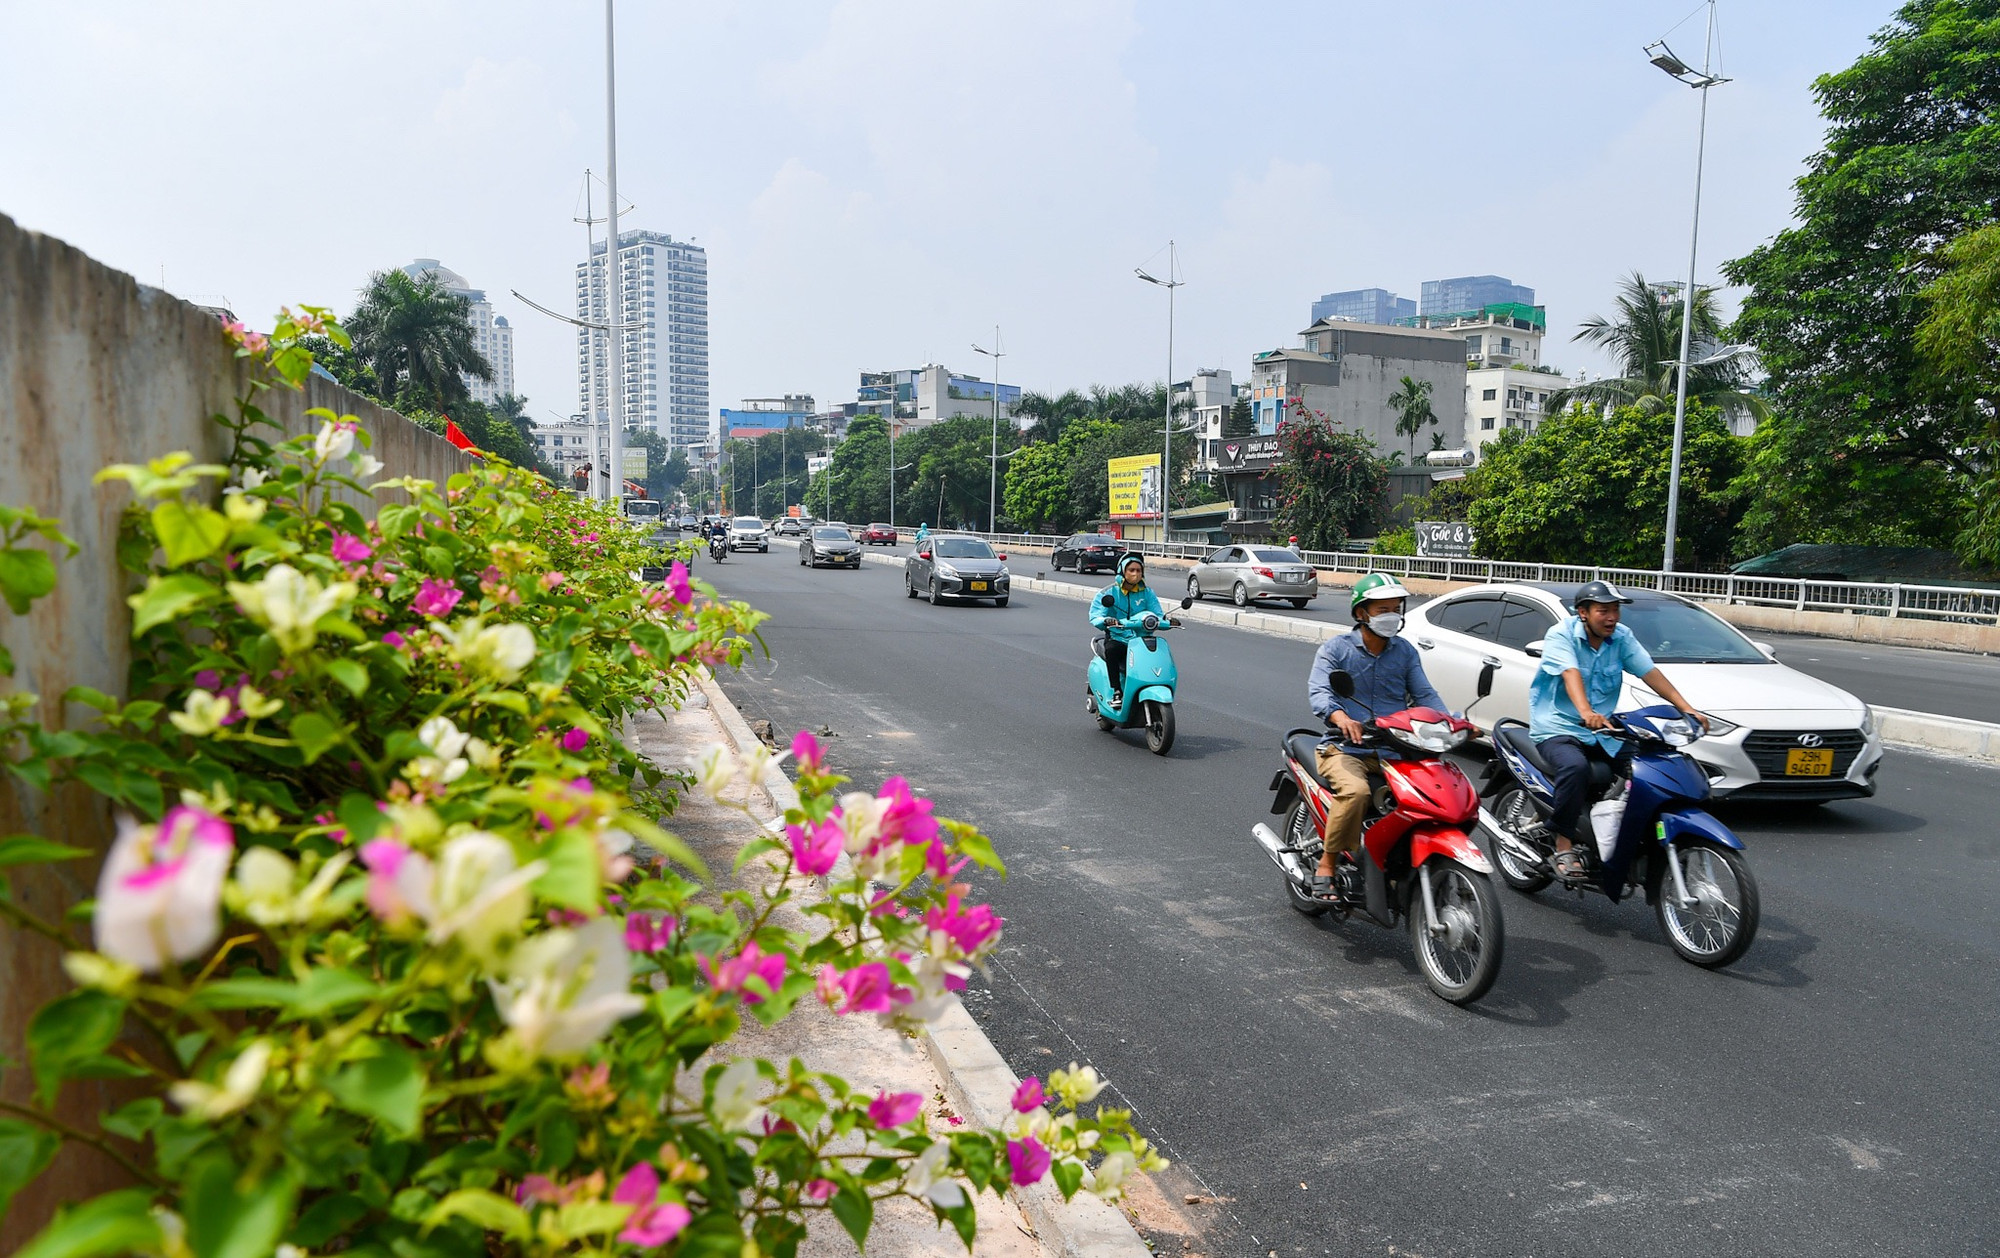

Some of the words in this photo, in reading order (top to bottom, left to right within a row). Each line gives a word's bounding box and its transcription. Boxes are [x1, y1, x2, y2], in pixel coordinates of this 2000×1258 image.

[1431, 525, 1450, 541] Tóc
[1453, 525, 1464, 543] &
[1791, 763, 1827, 774] 946.07
